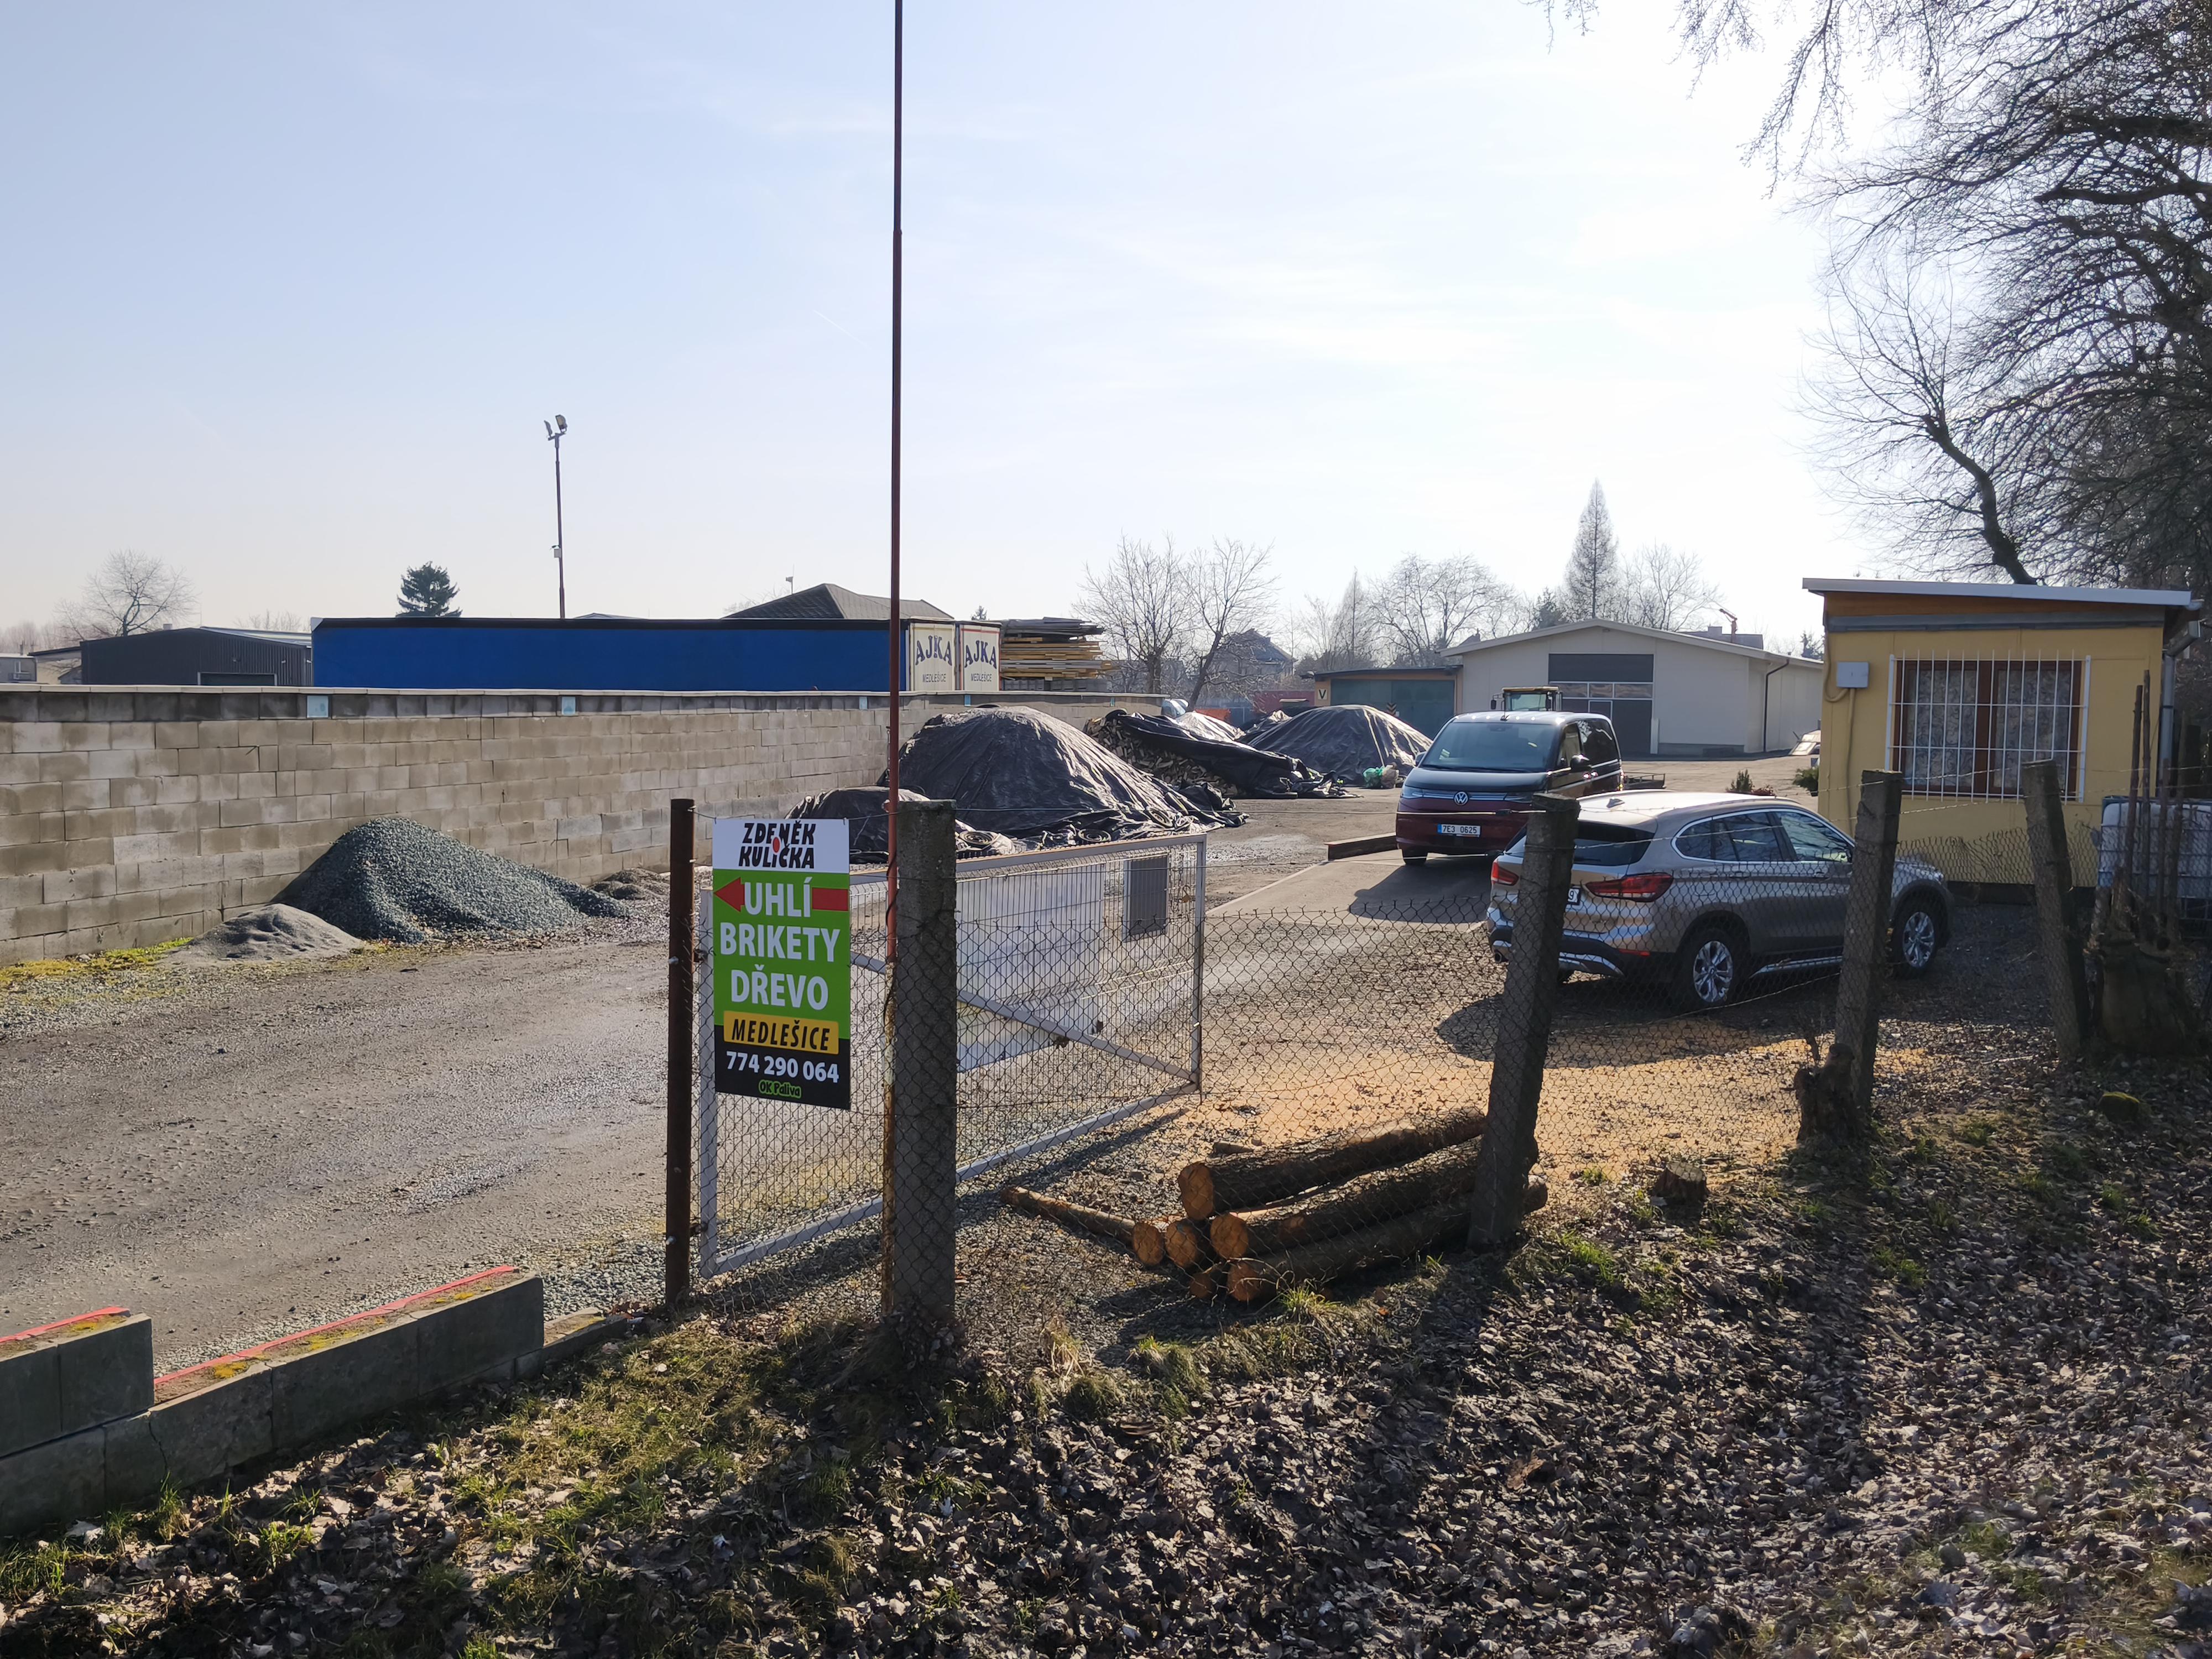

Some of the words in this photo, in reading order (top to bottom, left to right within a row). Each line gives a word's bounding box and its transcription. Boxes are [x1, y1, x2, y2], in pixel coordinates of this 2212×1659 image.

[915, 635, 952, 666] AJKA
[964, 640, 997, 669] AJKA
[922, 671, 946, 682] MEDLEŠCE
[1318, 689, 1326, 700] V
[742, 820, 816, 846] ZDENĚK
[738, 843, 815, 869] KULIČKA
[744, 877, 813, 917] UHLÍ
[720, 922, 841, 962] BRIKETY
[731, 964, 828, 1010] DŘEVO
[731, 1019, 830, 1051] MEDLEŠICE
[726, 1051, 760, 1073] 774
[764, 1055, 799, 1078] 290
[802, 1061, 839, 1083] 064
[759, 1081, 773, 1093] OK
[774, 1082, 801, 1097] Paliva
